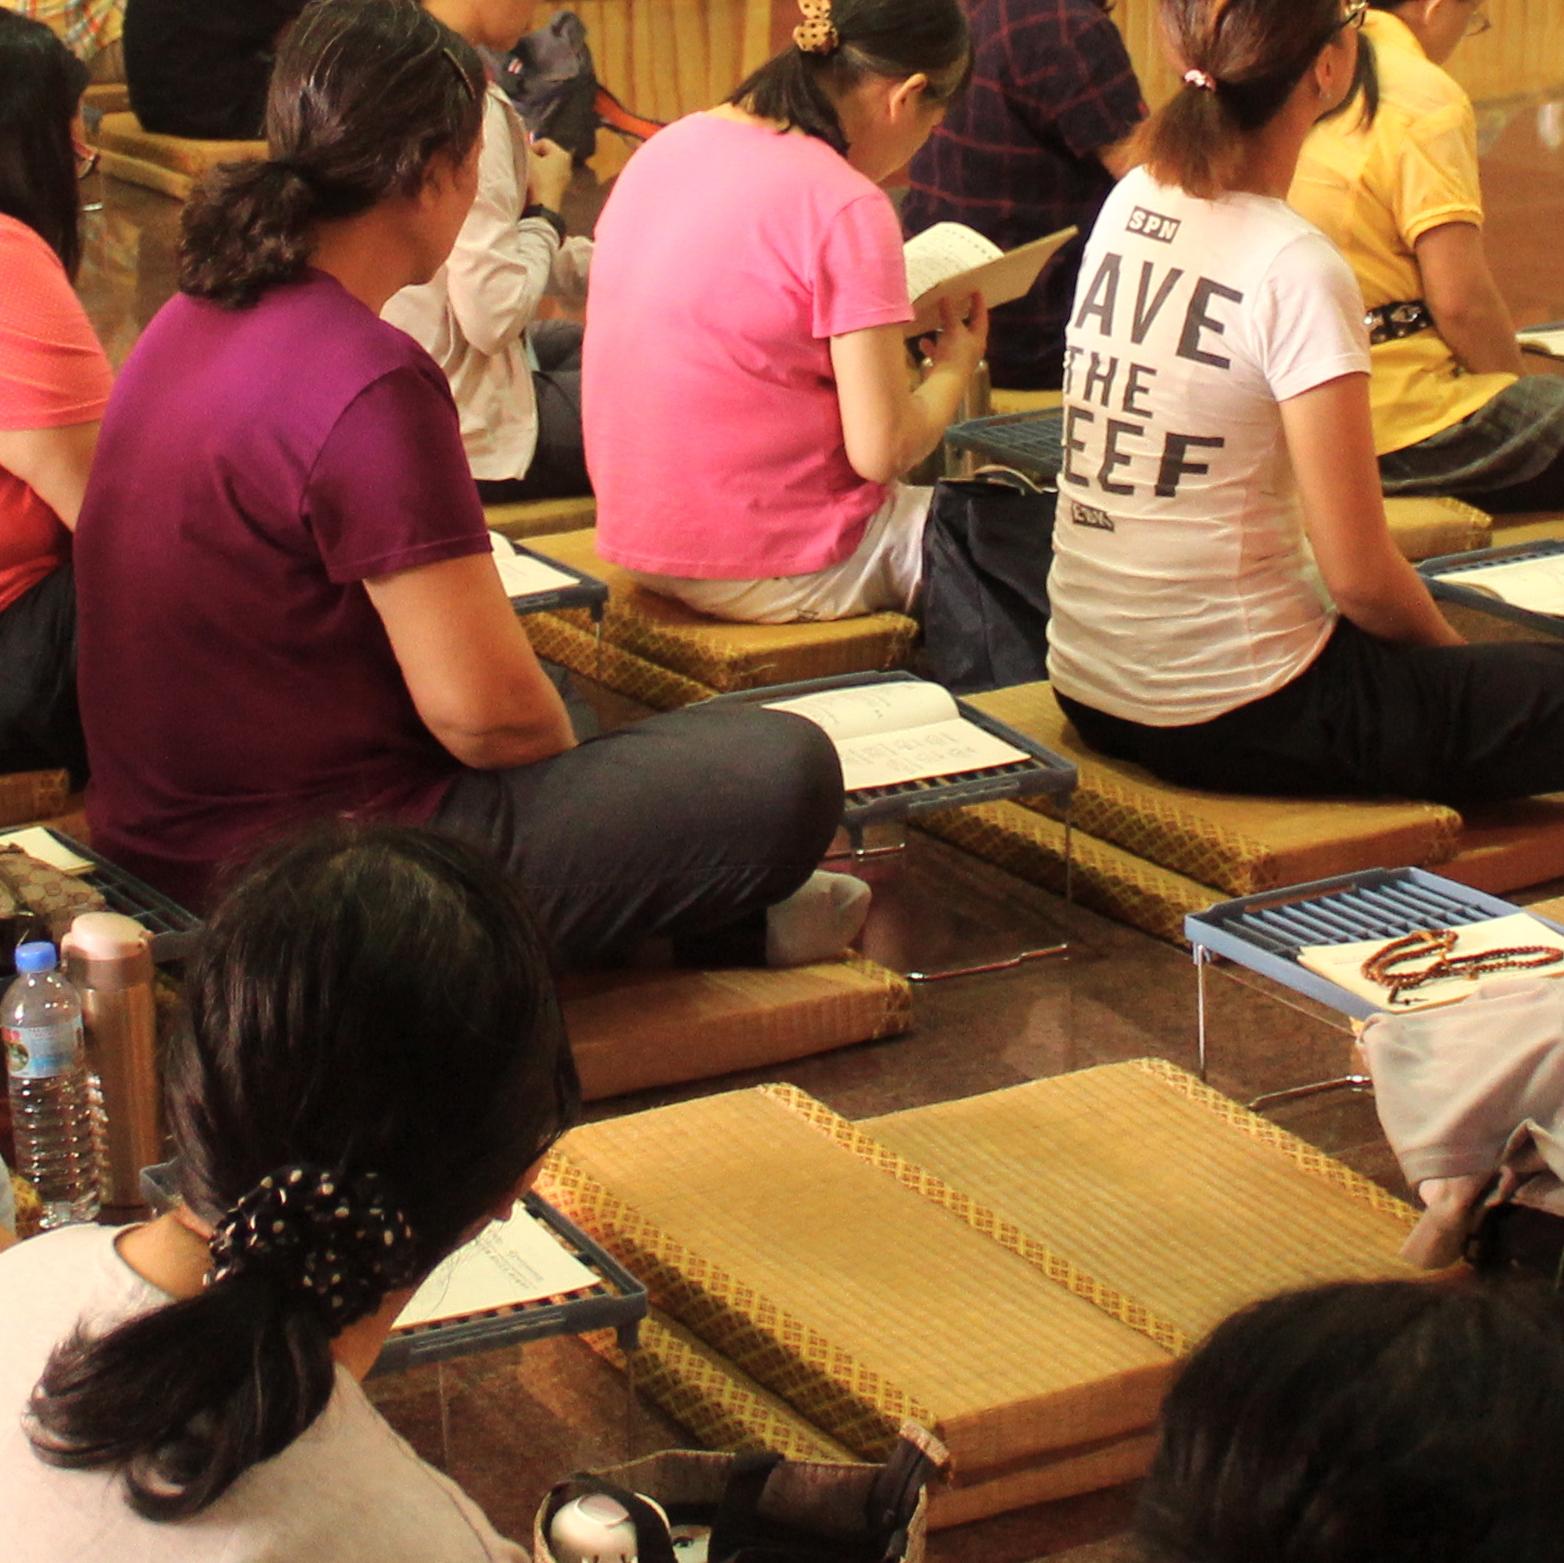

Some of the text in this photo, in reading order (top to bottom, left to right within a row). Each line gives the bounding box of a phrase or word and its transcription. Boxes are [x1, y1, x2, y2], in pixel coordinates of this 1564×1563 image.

[1127, 207, 1179, 241] SPN
[1074, 252, 1244, 370] AVE
[1065, 345, 1158, 418] THE
[1063, 404, 1225, 498] EEF
